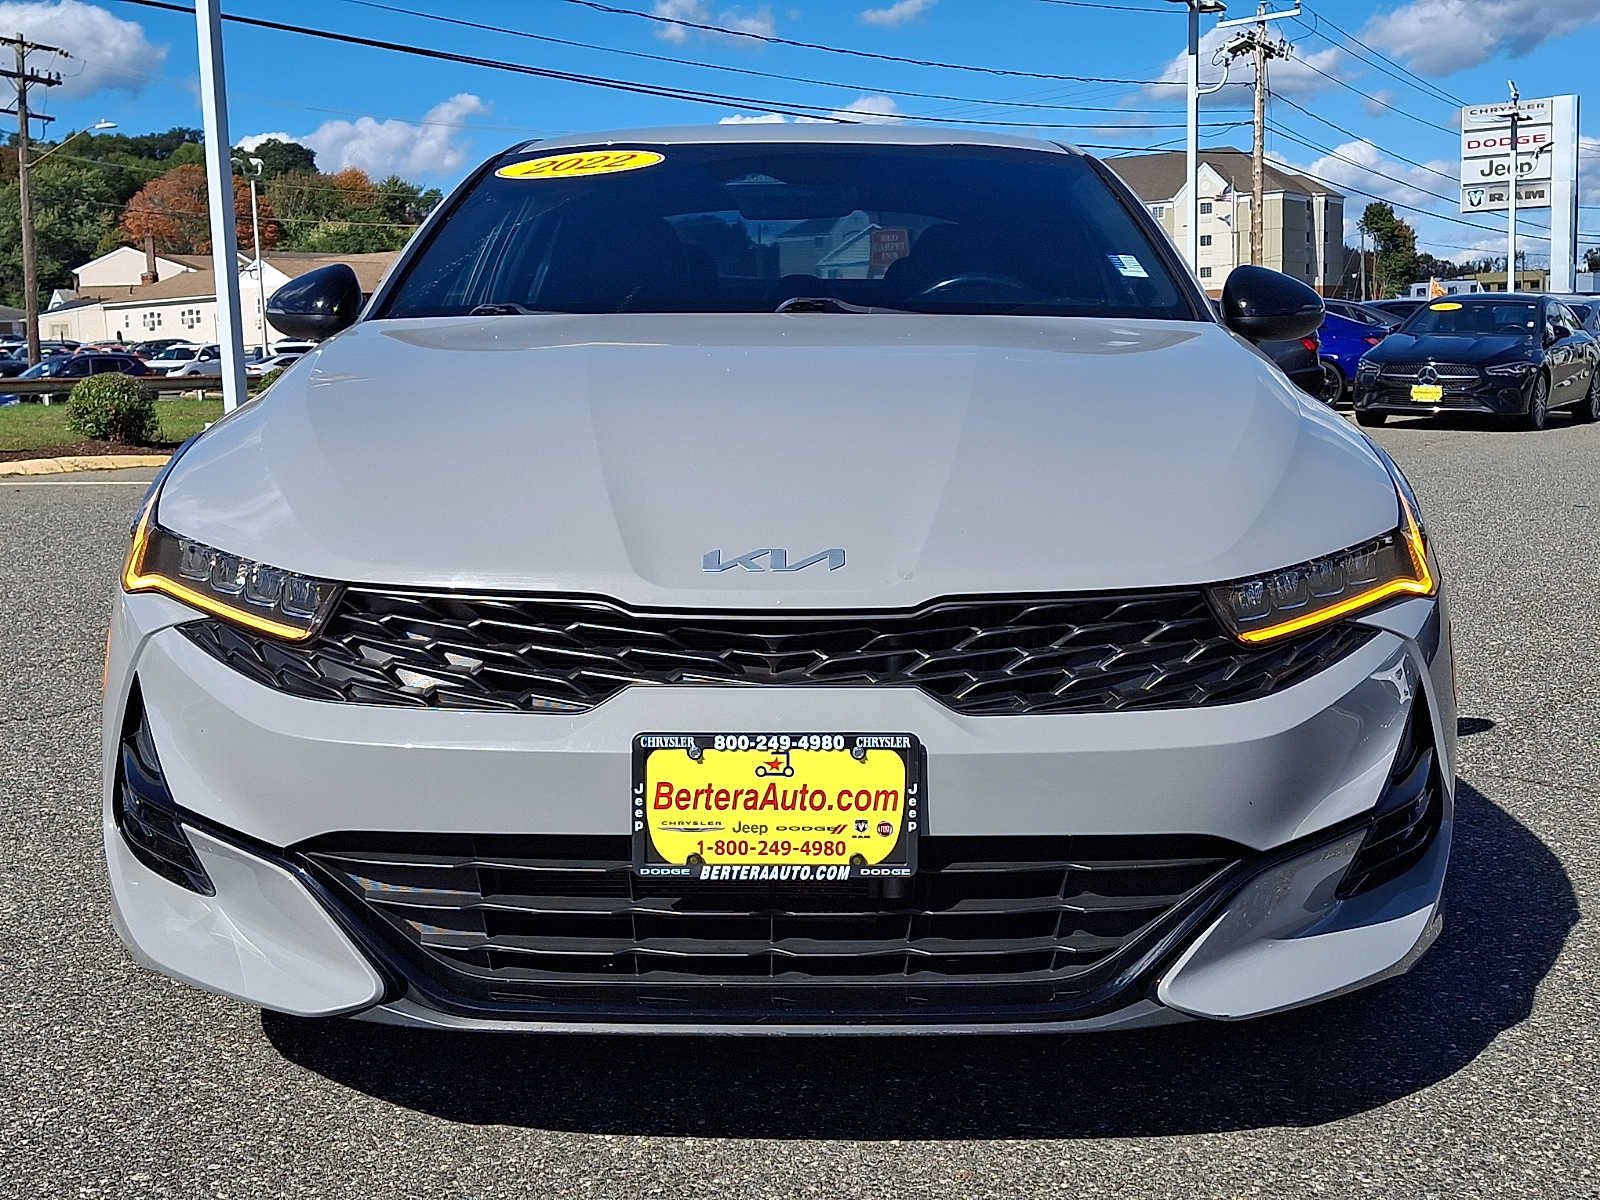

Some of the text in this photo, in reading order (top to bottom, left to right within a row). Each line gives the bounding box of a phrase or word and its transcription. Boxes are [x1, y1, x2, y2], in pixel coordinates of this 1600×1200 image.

[1467, 133, 1546, 150] DODGE
[520, 153, 638, 175] 2022
[640, 736, 695, 748] CHRYSLER
[713, 735, 845, 750] 800-249-4980
[855, 736, 911, 748] CHRYSLER
[653, 781, 899, 812] BerteraAuto.com
[633, 783, 644, 832] Jeep
[907, 783, 918, 833] Jeep
[732, 821, 769, 835] Jeep
[697, 840, 847, 857] 1-800-249-4980
[640, 865, 911, 881] DODGE BERTERAAUTO.COM DODGE
